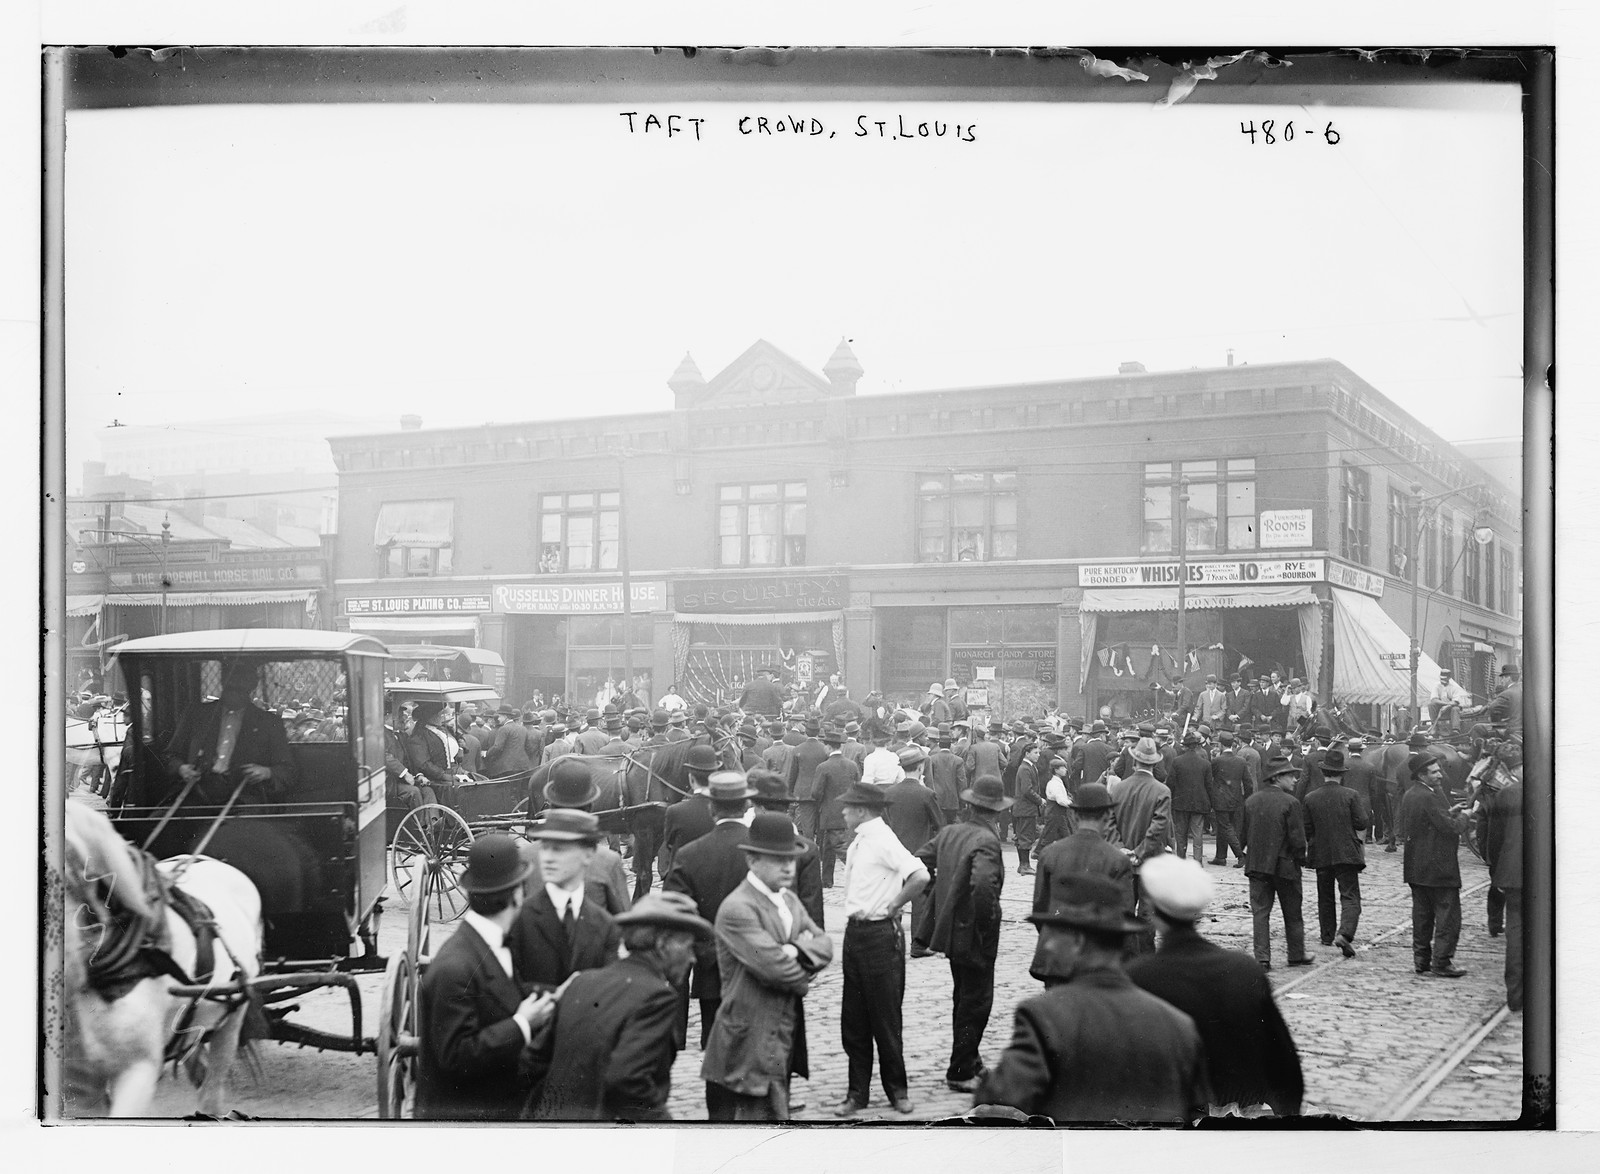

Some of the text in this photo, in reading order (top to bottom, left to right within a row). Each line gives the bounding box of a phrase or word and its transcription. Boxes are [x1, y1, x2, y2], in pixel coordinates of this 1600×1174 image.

[1264, 519, 1306, 531] ROOMS
[1084, 566, 1139, 576] PURE KENTUCKY
[1285, 561, 1306, 571] RYE
[136, 573, 154, 585] THE
[214, 569, 248, 583] HORSE
[252, 568, 274, 581] NAIL
[1090, 575, 1127, 583] BONDED
[1141, 565, 1203, 582] WHISKIES
[1282, 571, 1317, 579] BOURBON
[496, 586, 559, 609] RUSSELL'S
[562, 587, 608, 602] DINNER
[612, 586, 659, 601] HUSE.
[683, 577, 840, 607] SECURITY
[372, 599, 384, 611] ST.
[385, 599, 410, 611] LOUIS
[412, 598, 444, 611] PLATING
[447, 598, 461, 610] CO.
[516, 602, 536, 610] OPEN
[539, 602, 559, 610] DAILY
[612, 602, 618, 610] 3
[954, 650, 1056, 659] MONARCH CANDY STORE
